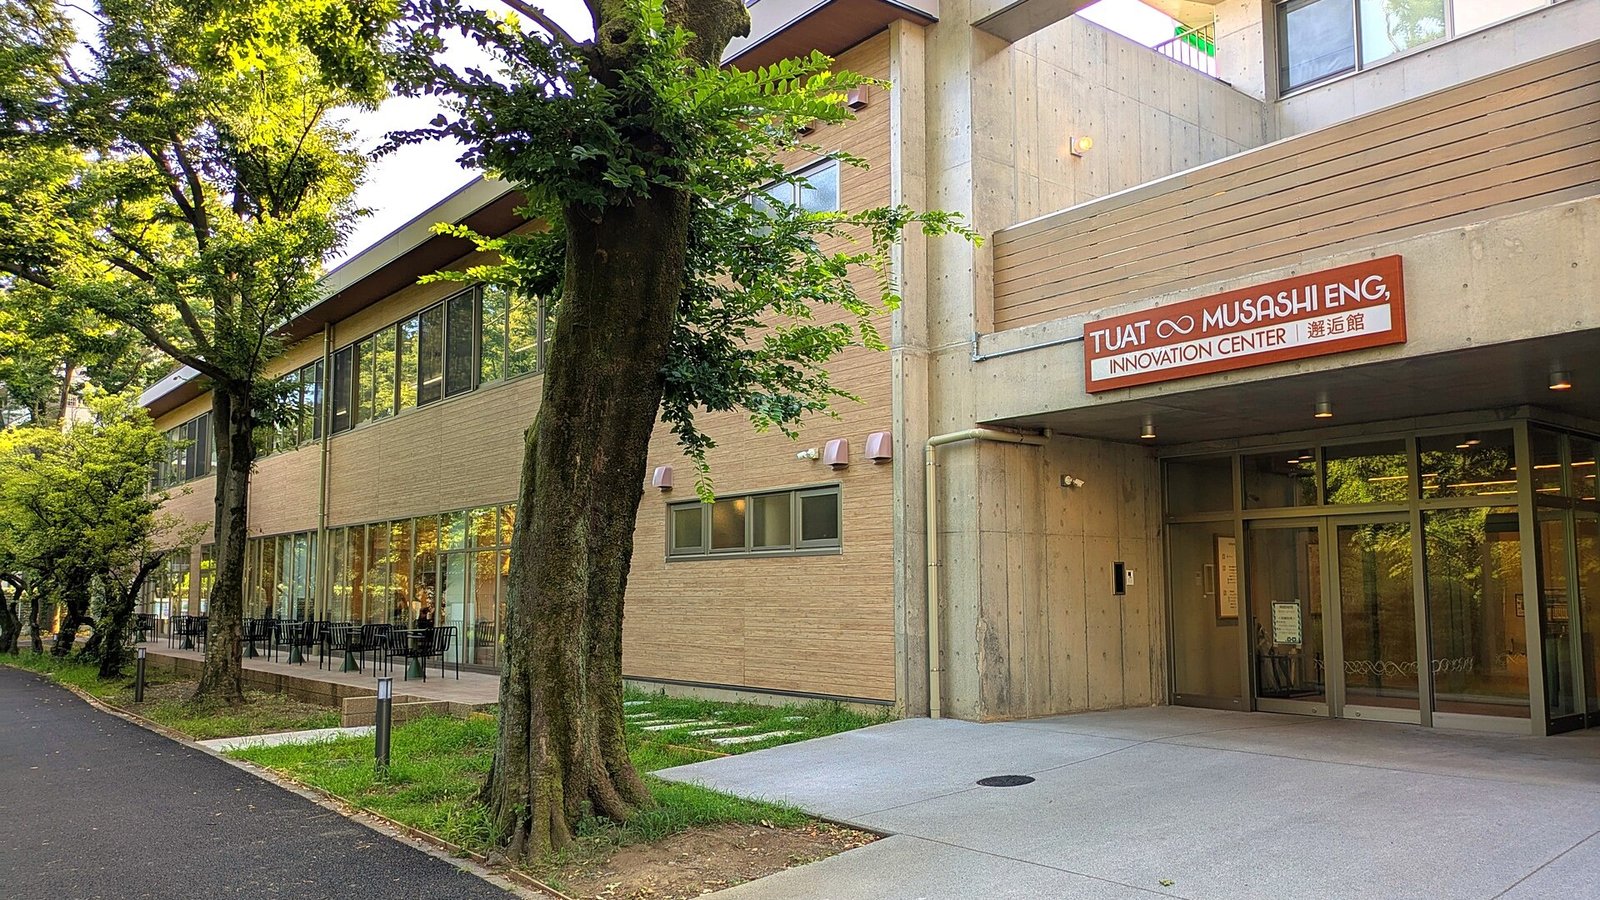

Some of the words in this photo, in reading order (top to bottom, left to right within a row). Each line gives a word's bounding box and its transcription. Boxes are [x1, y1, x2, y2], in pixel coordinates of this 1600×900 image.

[1090, 320, 1150, 353] TUAT
[1202, 285, 1318, 332] MUSASHI
[1306, 313, 1365, 339] 邂逅館
[1109, 343, 1212, 374] INNOVATION
[1217, 328, 1287, 355] CENTER
